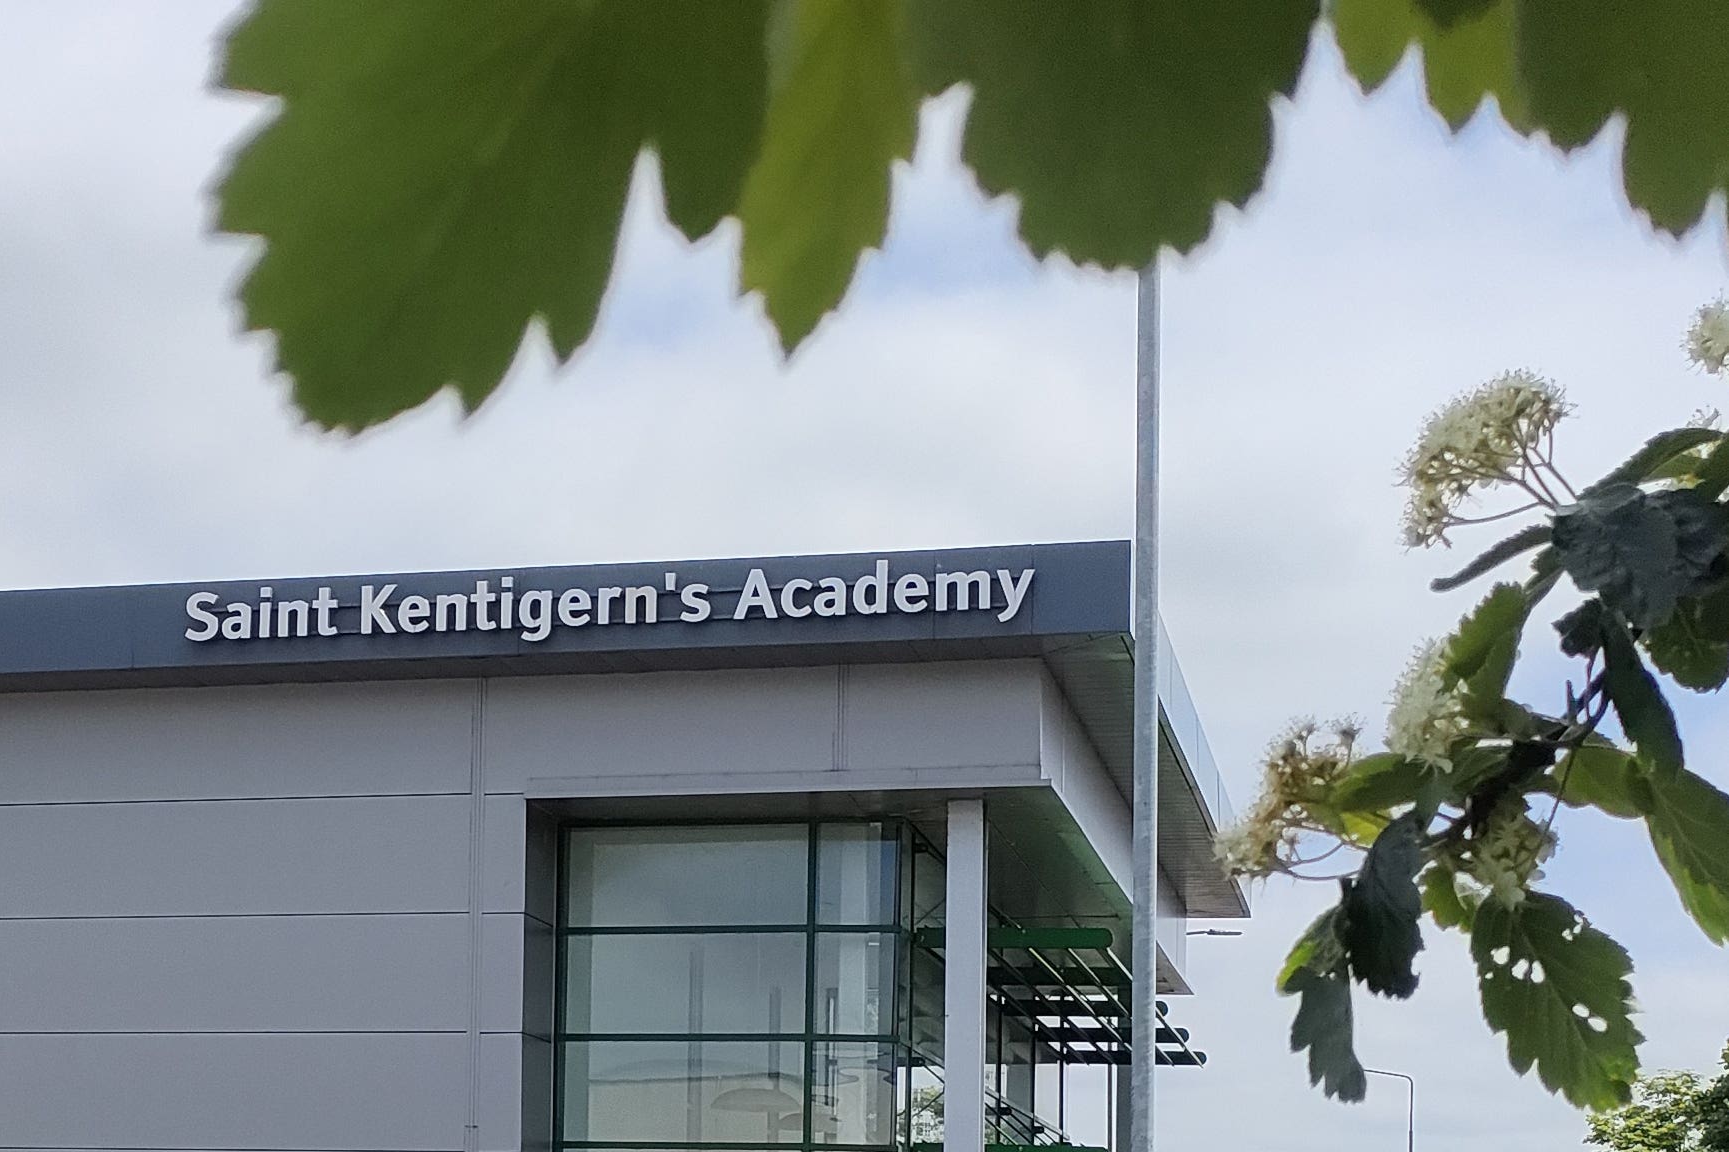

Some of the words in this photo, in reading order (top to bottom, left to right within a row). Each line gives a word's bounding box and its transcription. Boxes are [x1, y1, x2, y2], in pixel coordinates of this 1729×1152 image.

[183, 585, 339, 643] Saint
[359, 571, 712, 643] Kentigern's
[733, 559, 1037, 624] Academy
